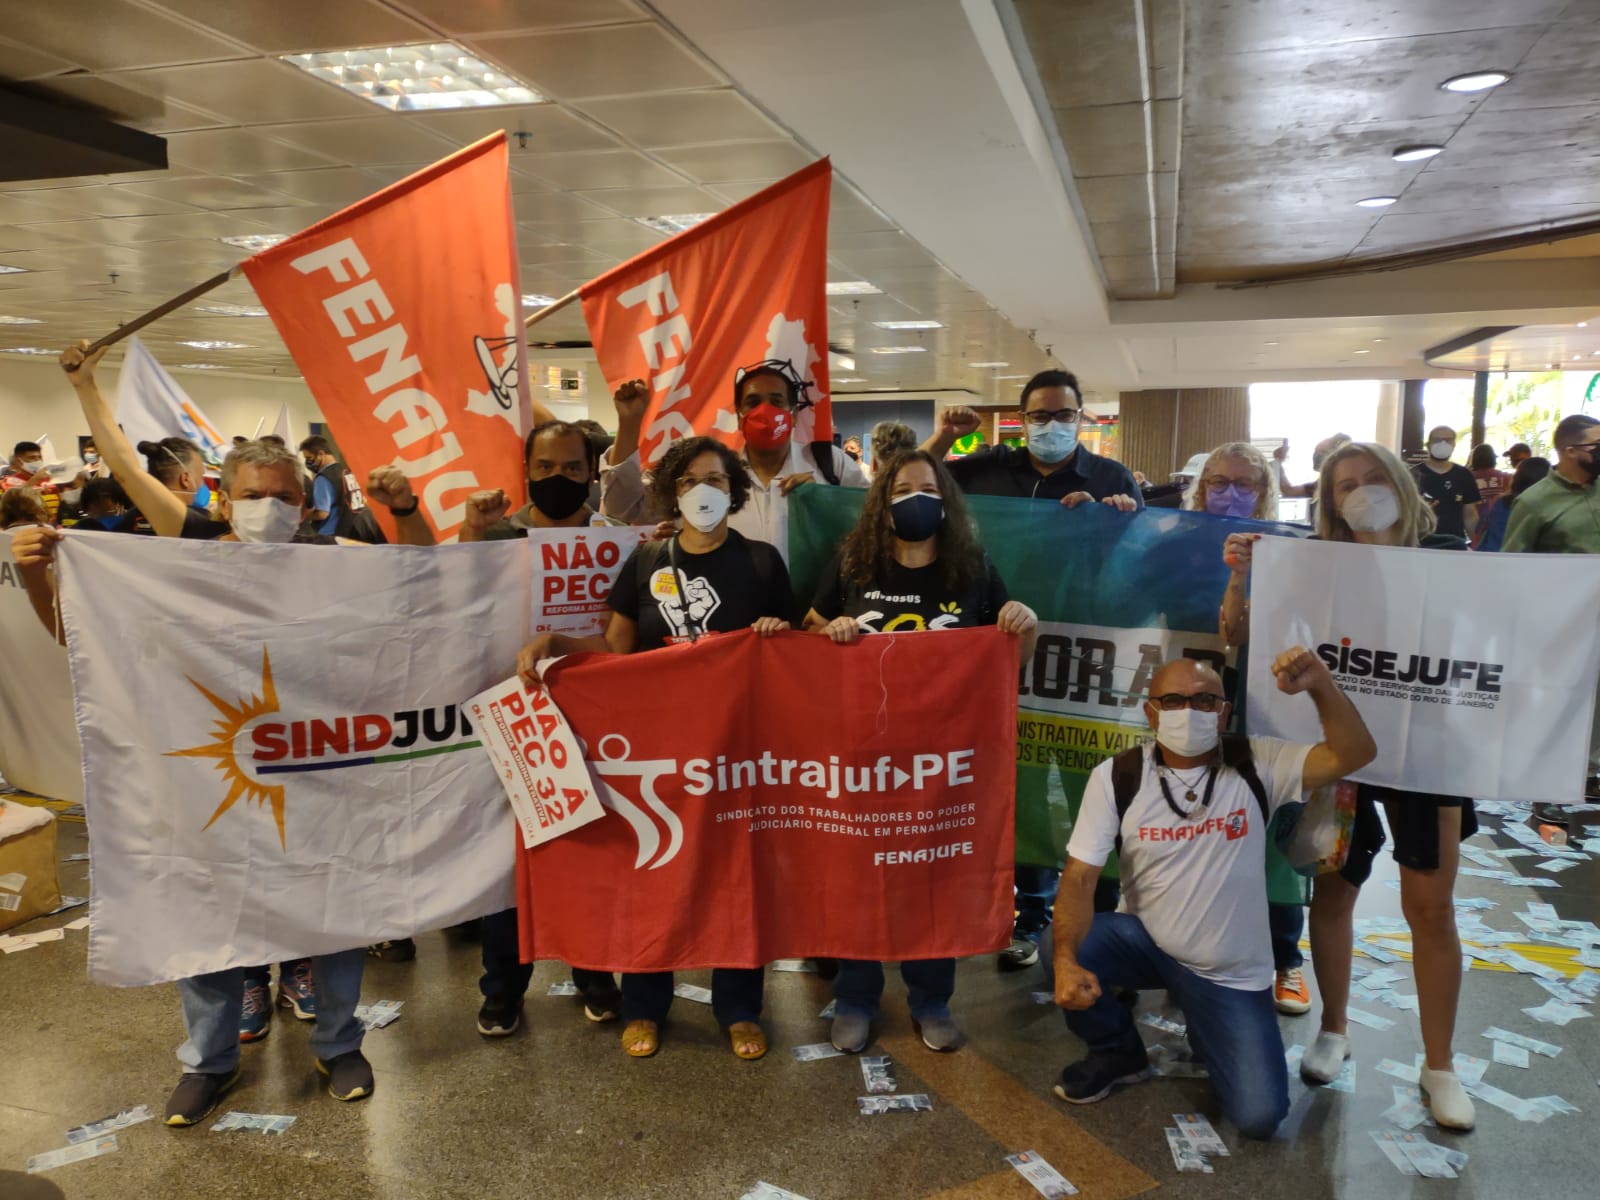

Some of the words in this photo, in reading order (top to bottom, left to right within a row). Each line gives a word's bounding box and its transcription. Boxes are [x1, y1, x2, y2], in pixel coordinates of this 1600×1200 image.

[616, 271, 696, 463] FENA
[290, 237, 479, 544] FENAJU
[541, 535, 620, 570] NÃO
[543, 573, 611, 603] PEC
[1360, 679, 1378, 687] DOS
[1374, 689, 1408, 700] ESTADO
[1410, 694, 1421, 702] DO
[1423, 695, 1439, 704] RIO
[524, 686, 567, 769] NÃO
[1017, 720, 1098, 748] NISTRATIVA
[491, 705, 514, 748] REFORMA
[512, 749, 547, 823] ADMINISTRATIVA
[500, 691, 546, 769] PEC
[536, 776, 565, 824] 32
[1016, 742, 1033, 760] OS
[715, 806, 776, 822] SINDICATO
[781, 805, 805, 815] DOS
[809, 807, 912, 823] TRABALHADORES
[917, 810, 933, 820] DO
[938, 803, 975, 817] PODER
[748, 819, 813, 832] JUDICIÁRIO
[816, 822, 870, 837] FEDERAL
[874, 827, 891, 837] EM
[896, 816, 976, 835] PERNAMBUCO
[1138, 817, 1225, 841] FENAJUFE
[874, 841, 974, 866] FENAJUFE
